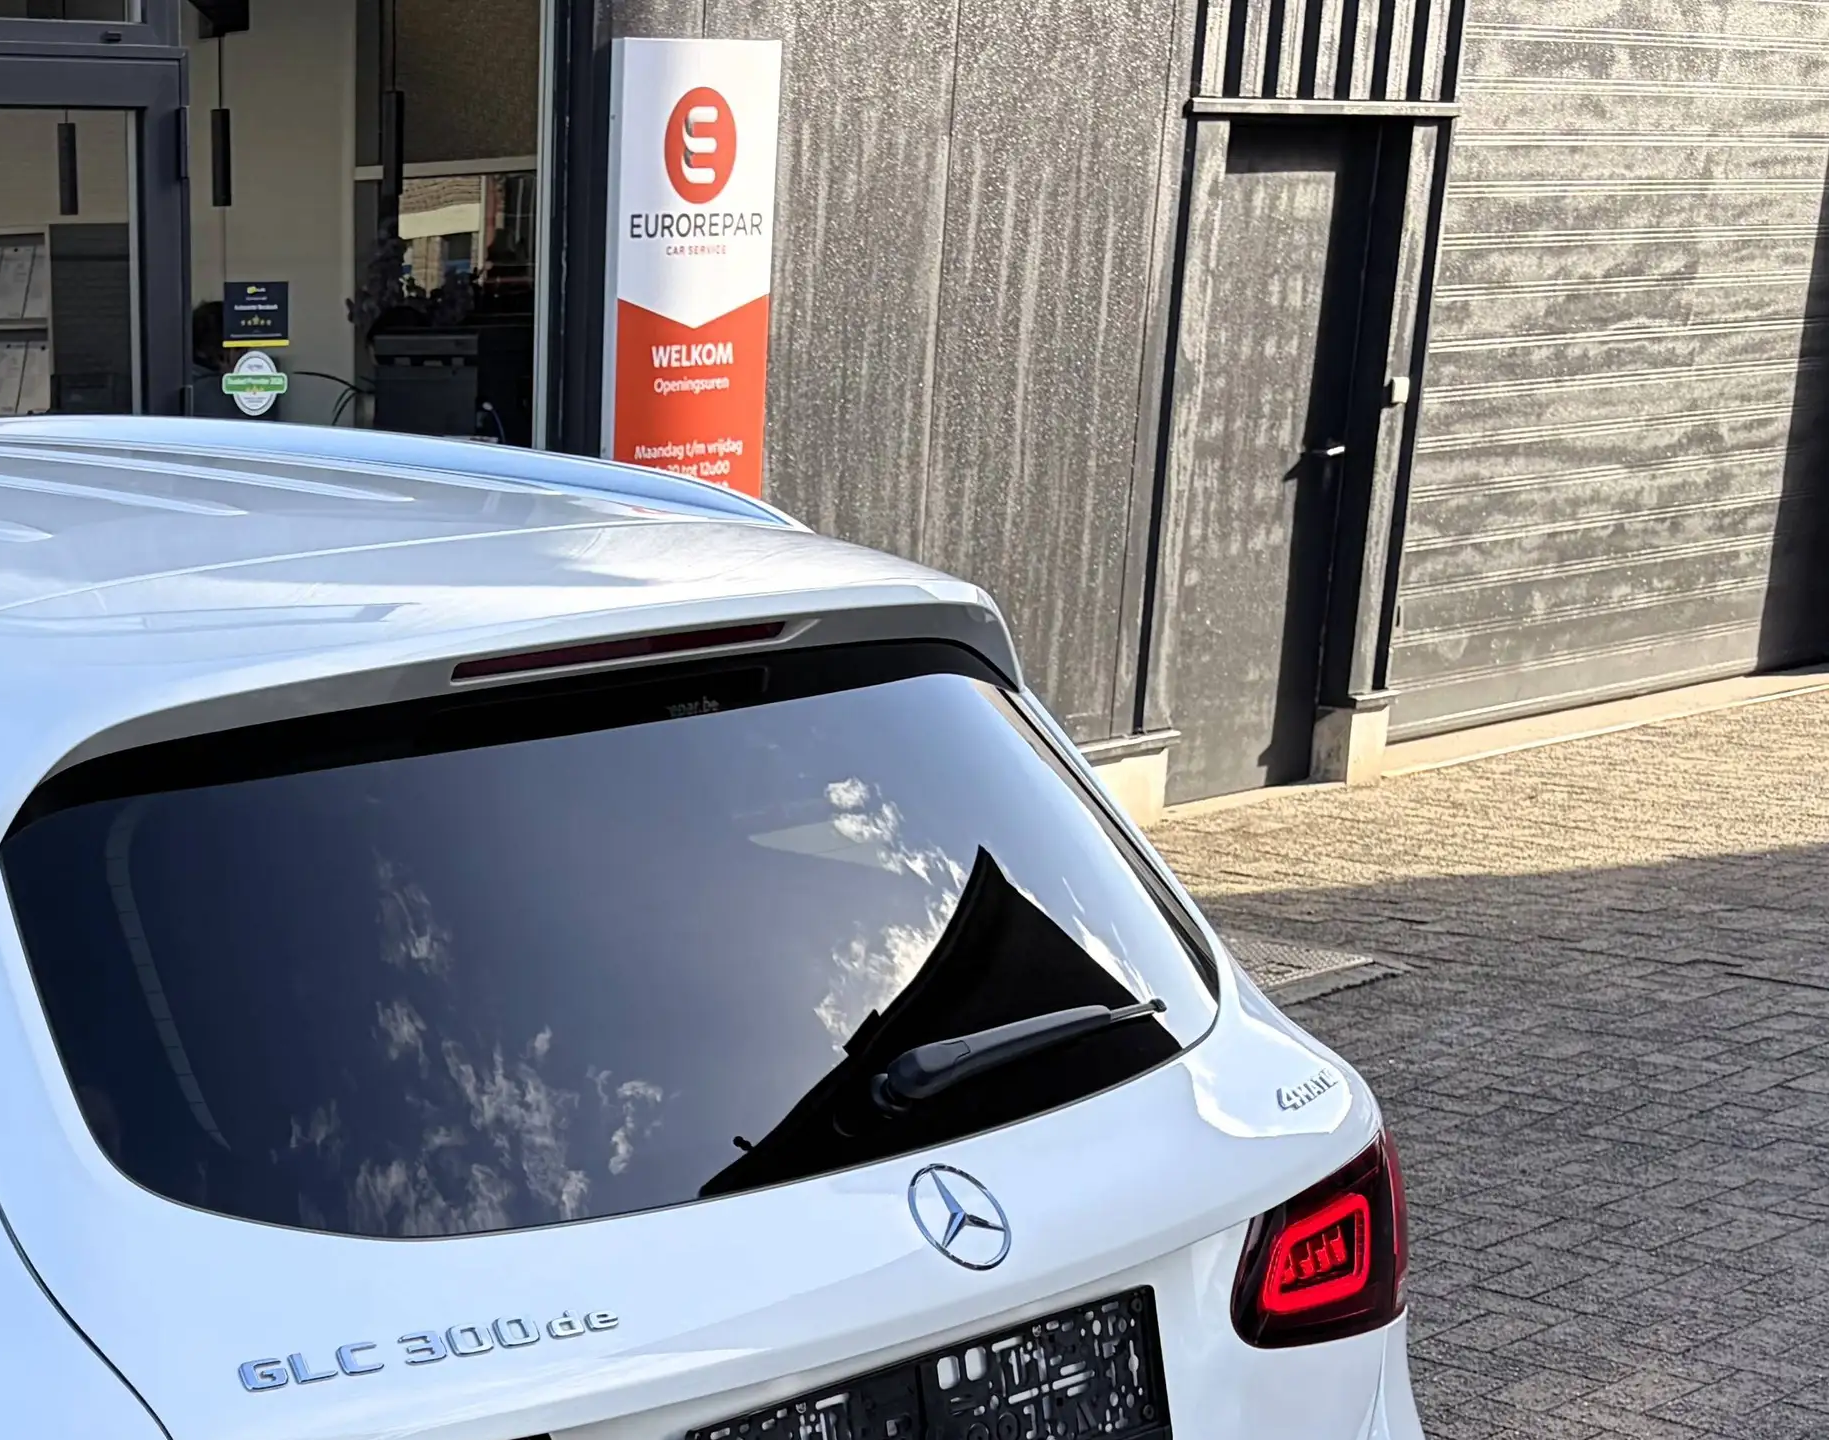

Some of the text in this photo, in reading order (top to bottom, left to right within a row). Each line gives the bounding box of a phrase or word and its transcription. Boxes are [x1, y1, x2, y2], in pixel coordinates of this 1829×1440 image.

[629, 212, 764, 238] EUROREPAR
[665, 245, 727, 256] CAR SERVICE
[651, 341, 734, 368] WELKOM
[653, 376, 730, 396] Openingsuren
[634, 436, 743, 460] Maandag t/m vrijdag
[699, 459, 731, 477] 12u00
[238, 1340, 385, 1392] GLC
